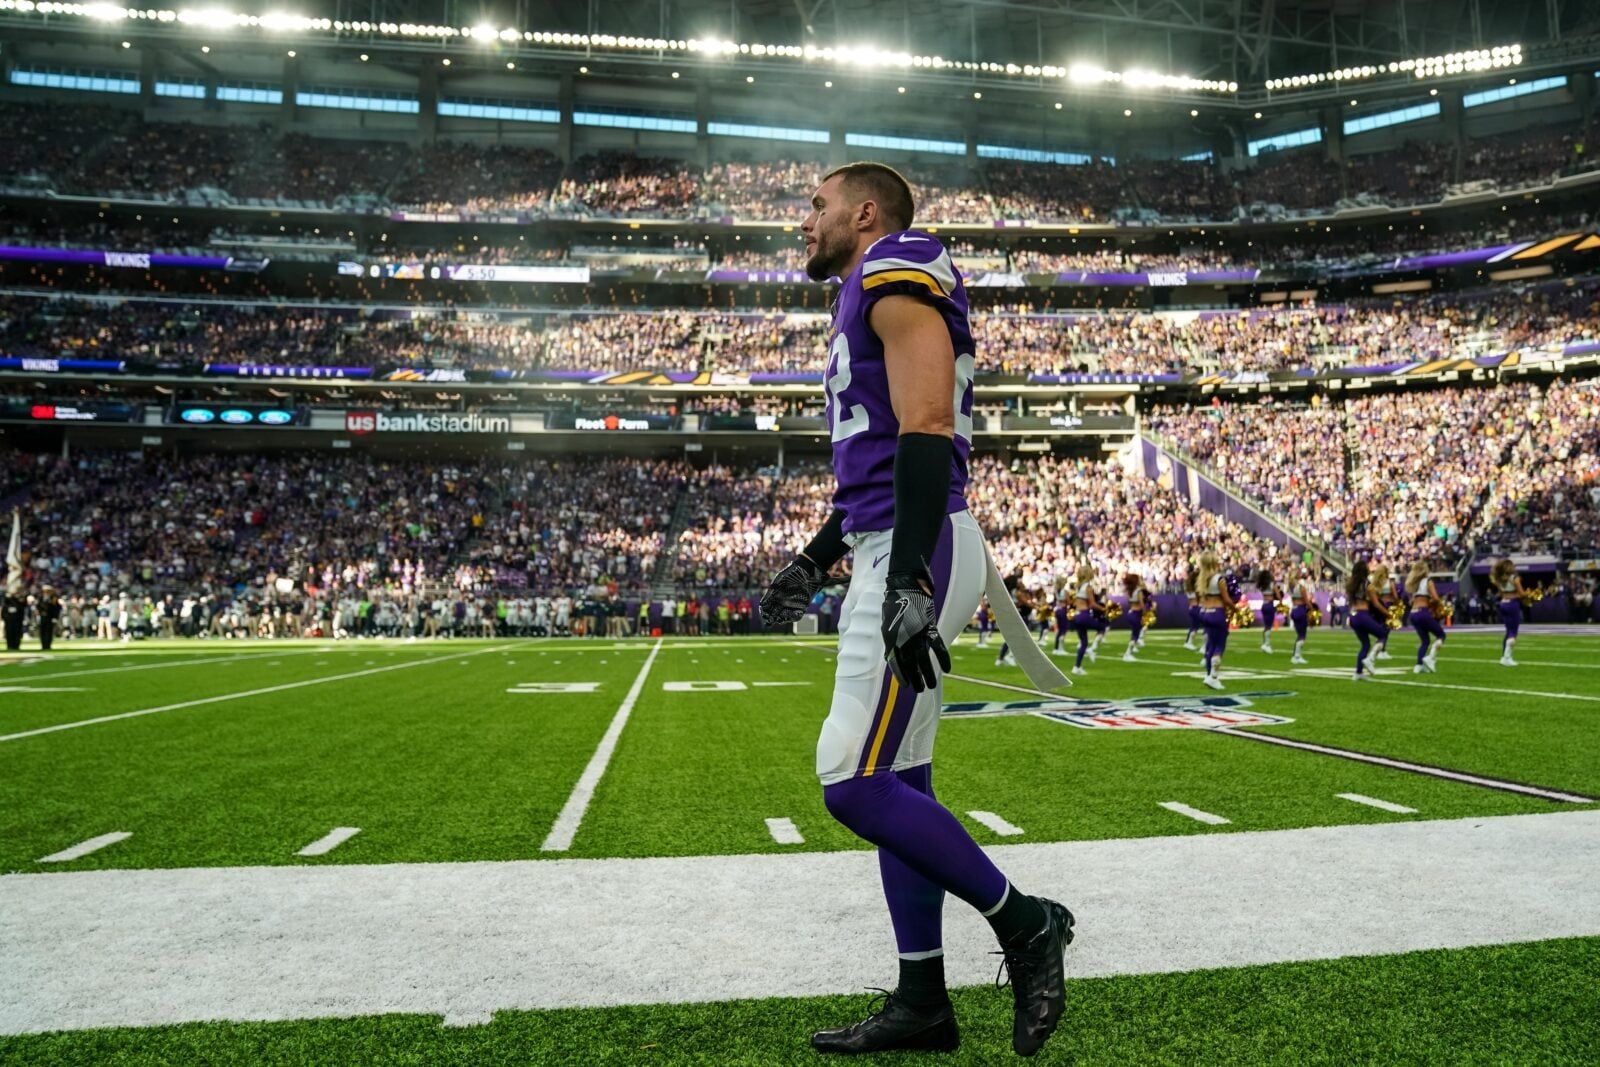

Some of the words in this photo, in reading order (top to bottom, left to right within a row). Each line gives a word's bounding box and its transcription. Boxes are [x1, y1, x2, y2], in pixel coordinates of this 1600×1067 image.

[104, 251, 151, 268] VIKINGS
[467, 268, 496, 280] 5:50
[1147, 272, 1187, 286] VIKINGS
[22, 358, 60, 371] VIKINGS
[618, 417, 649, 430] Farm
